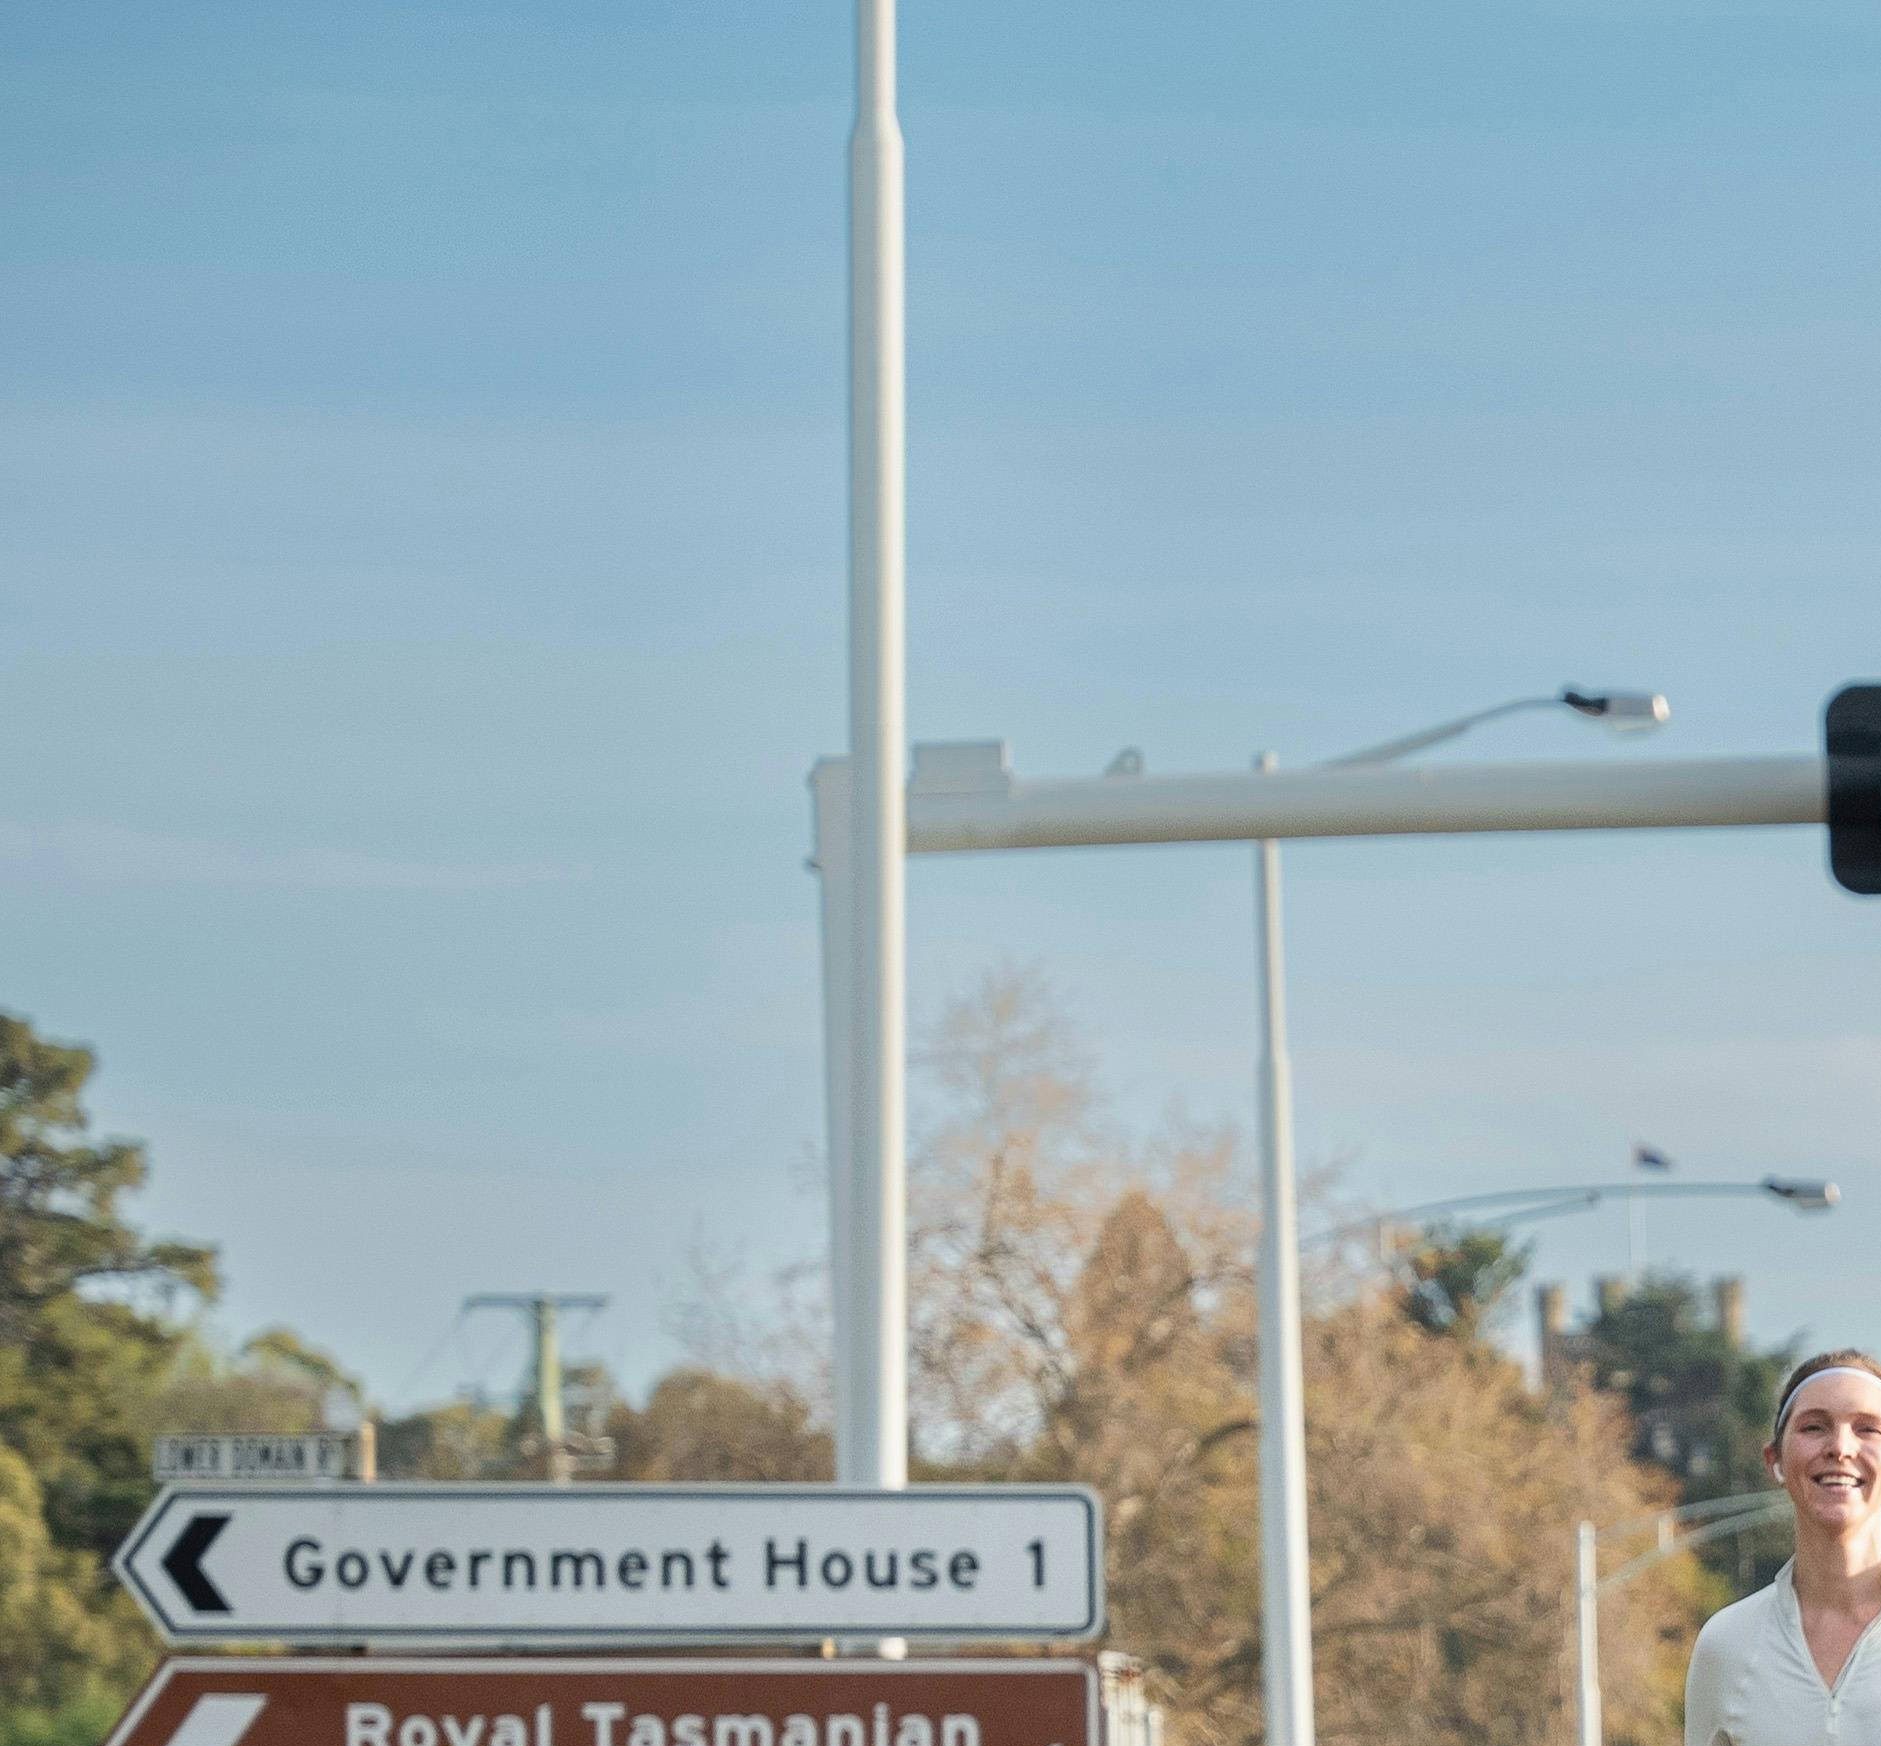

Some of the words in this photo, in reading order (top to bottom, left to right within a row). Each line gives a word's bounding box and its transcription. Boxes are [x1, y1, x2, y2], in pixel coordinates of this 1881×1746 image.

[284, 1535, 731, 1591] Government
[764, 1537, 981, 1590] House
[1025, 1537, 1047, 1589] 1
